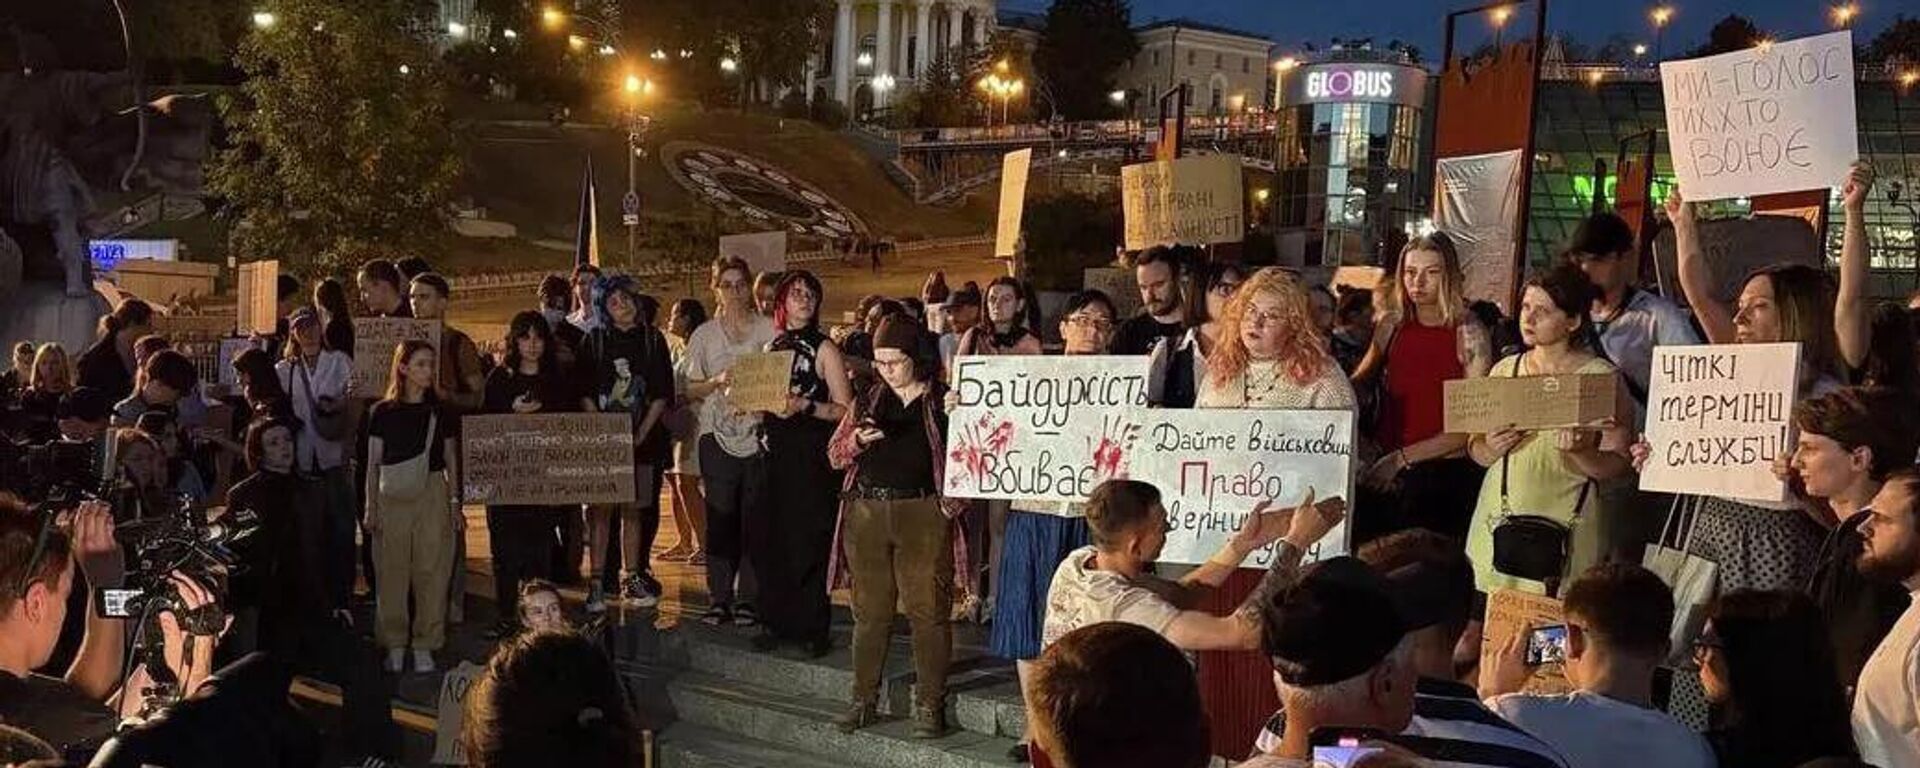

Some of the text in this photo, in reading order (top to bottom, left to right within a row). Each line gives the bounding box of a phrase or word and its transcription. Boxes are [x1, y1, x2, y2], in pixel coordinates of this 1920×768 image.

[1307, 69, 1393, 98] GLOBUS
[1689, 128, 1813, 179] ВОЮЄ
[958, 361, 1149, 428] Байдужість
[1152, 422, 1237, 452] Дайте
[1180, 461, 1282, 510] Право
